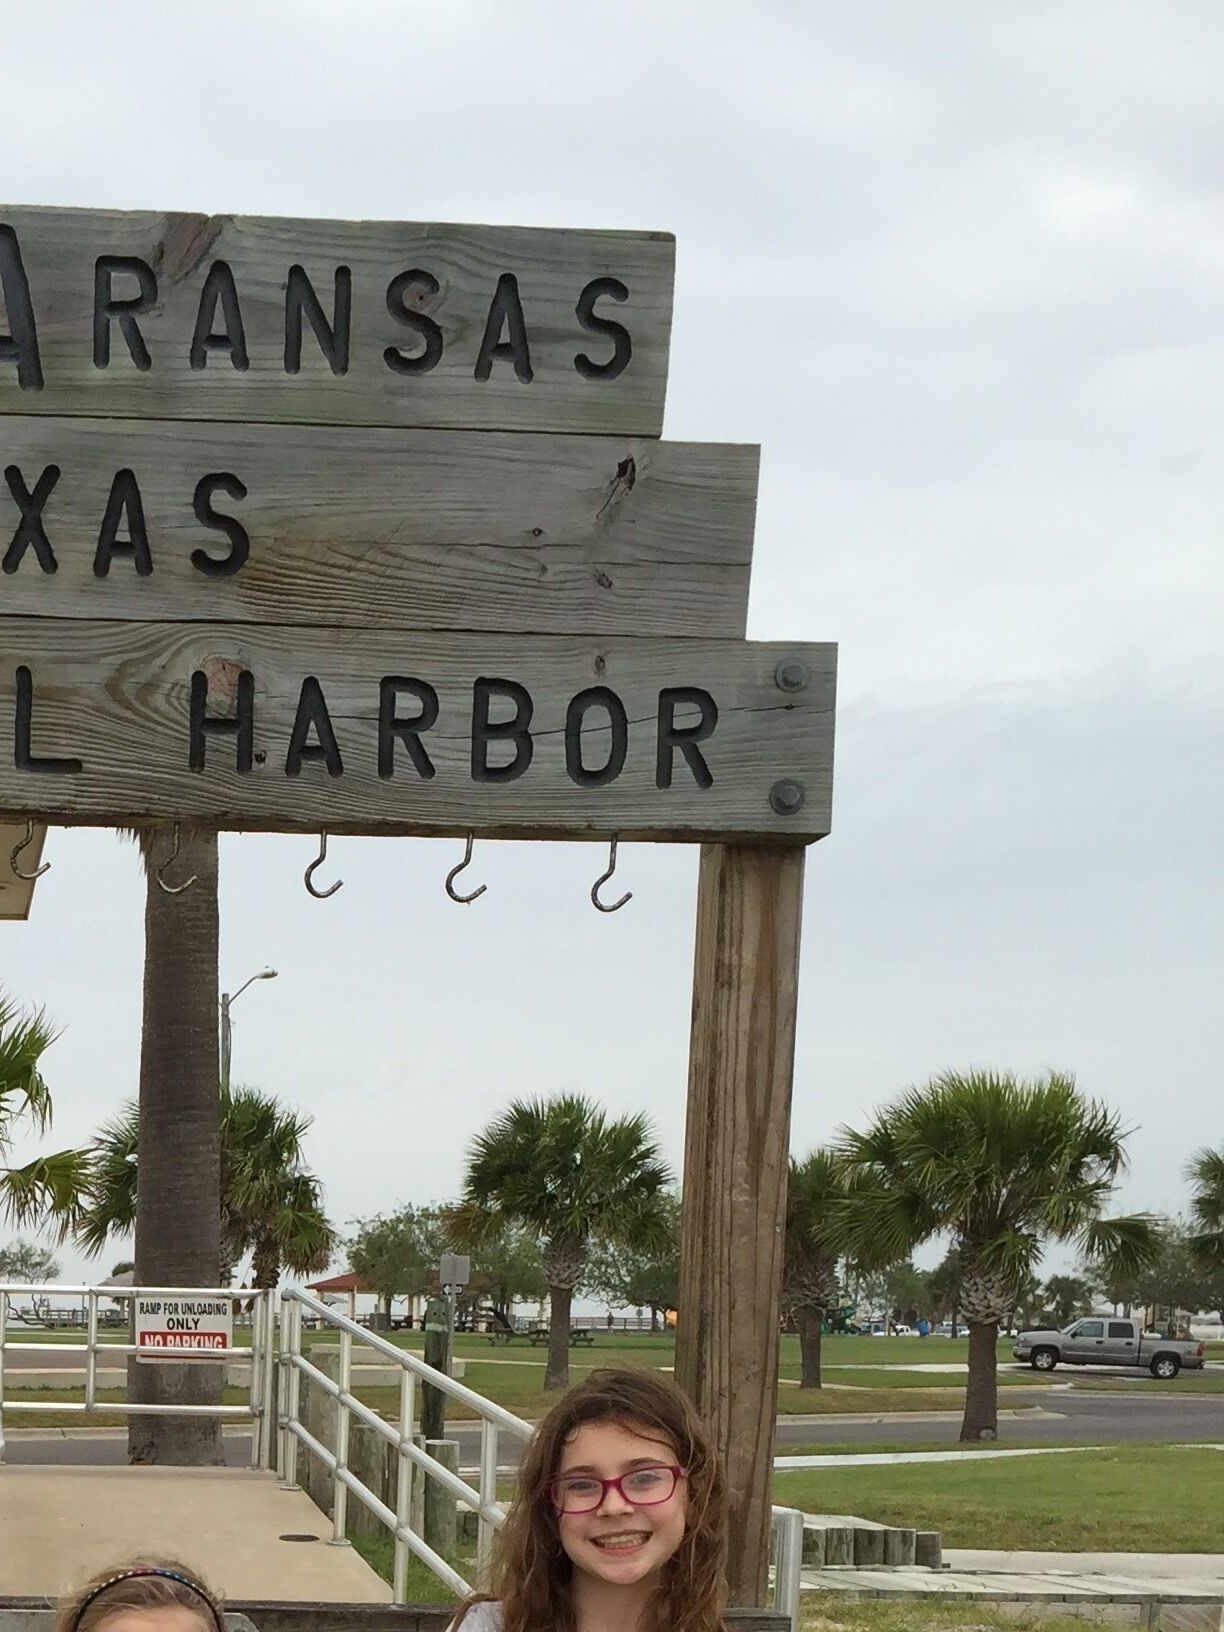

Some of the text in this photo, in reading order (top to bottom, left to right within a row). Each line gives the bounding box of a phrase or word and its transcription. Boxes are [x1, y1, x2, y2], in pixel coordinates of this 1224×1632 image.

[188, 670, 719, 789] HARBOR
[139, 1302, 227, 1315] RAMP FOR UNLOADING
[167, 1318, 200, 1330] ONLY
[144, 1334, 223, 1349] NO PARKING
